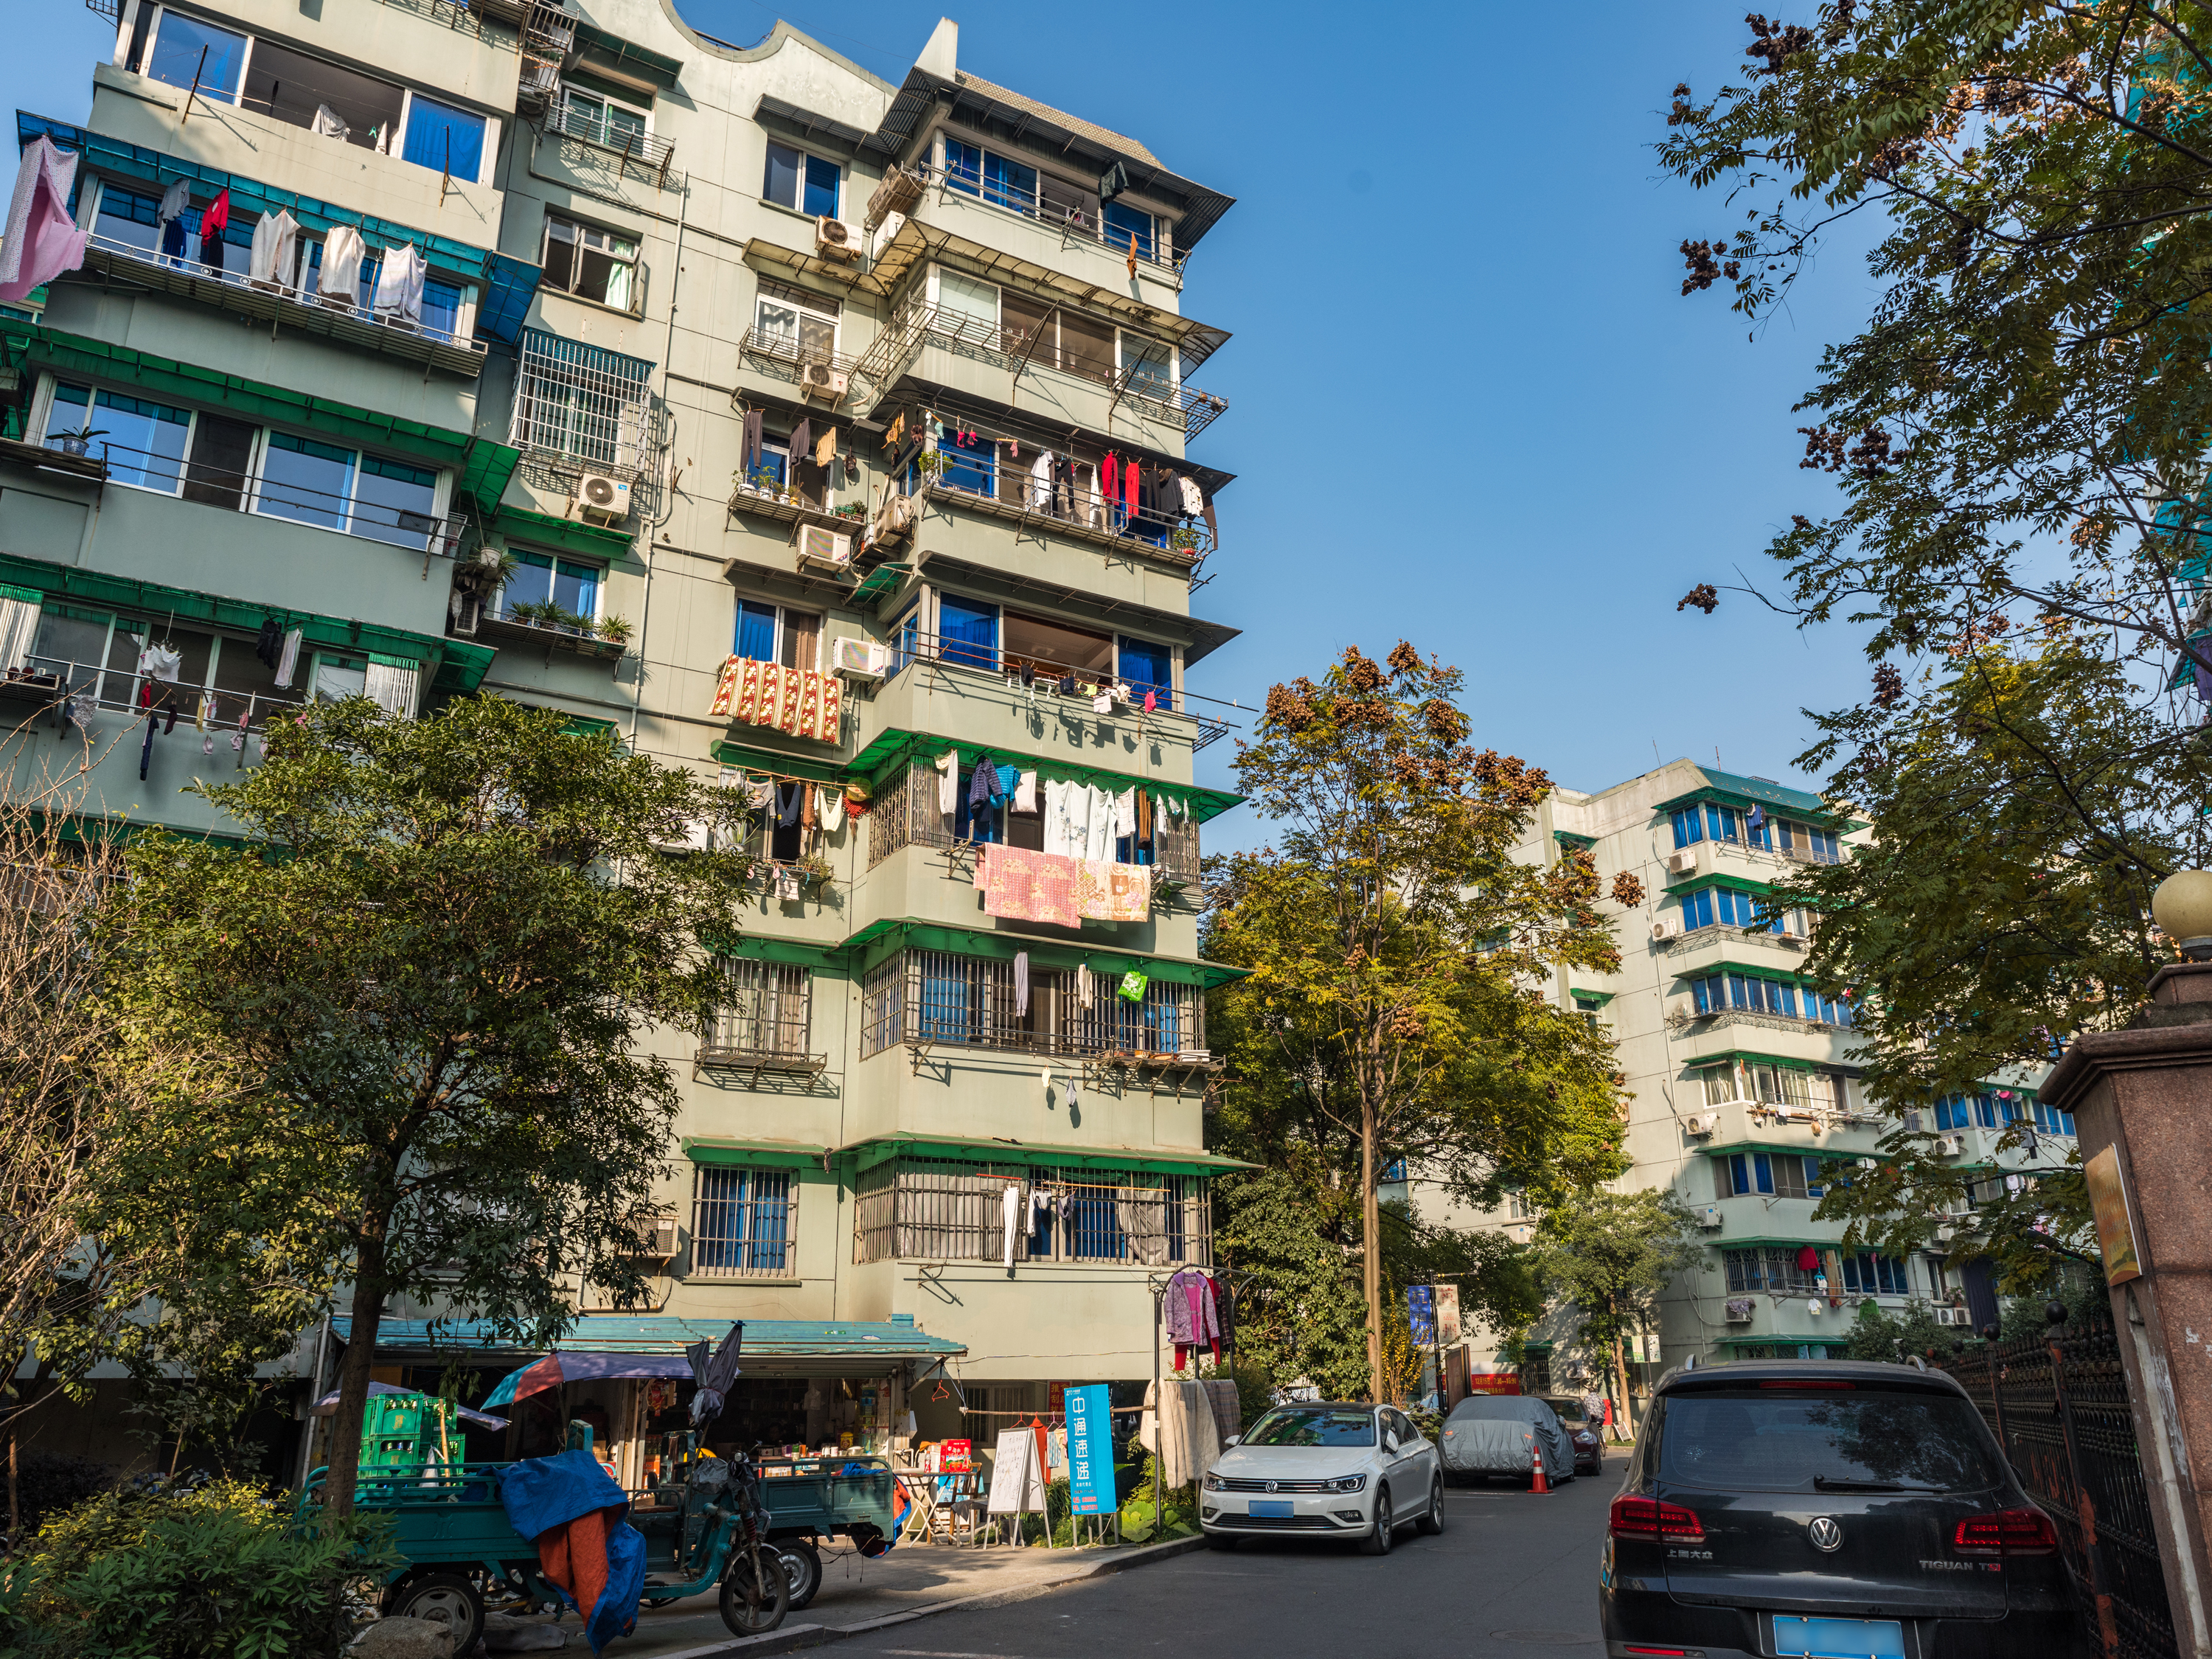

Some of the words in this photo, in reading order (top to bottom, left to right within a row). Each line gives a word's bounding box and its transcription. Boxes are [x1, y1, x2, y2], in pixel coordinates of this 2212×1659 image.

[1072, 1396, 1089, 1480] 中通速递
[1919, 1560, 1973, 1571] TIGUAN
[1979, 1562, 2001, 1571] TSI
